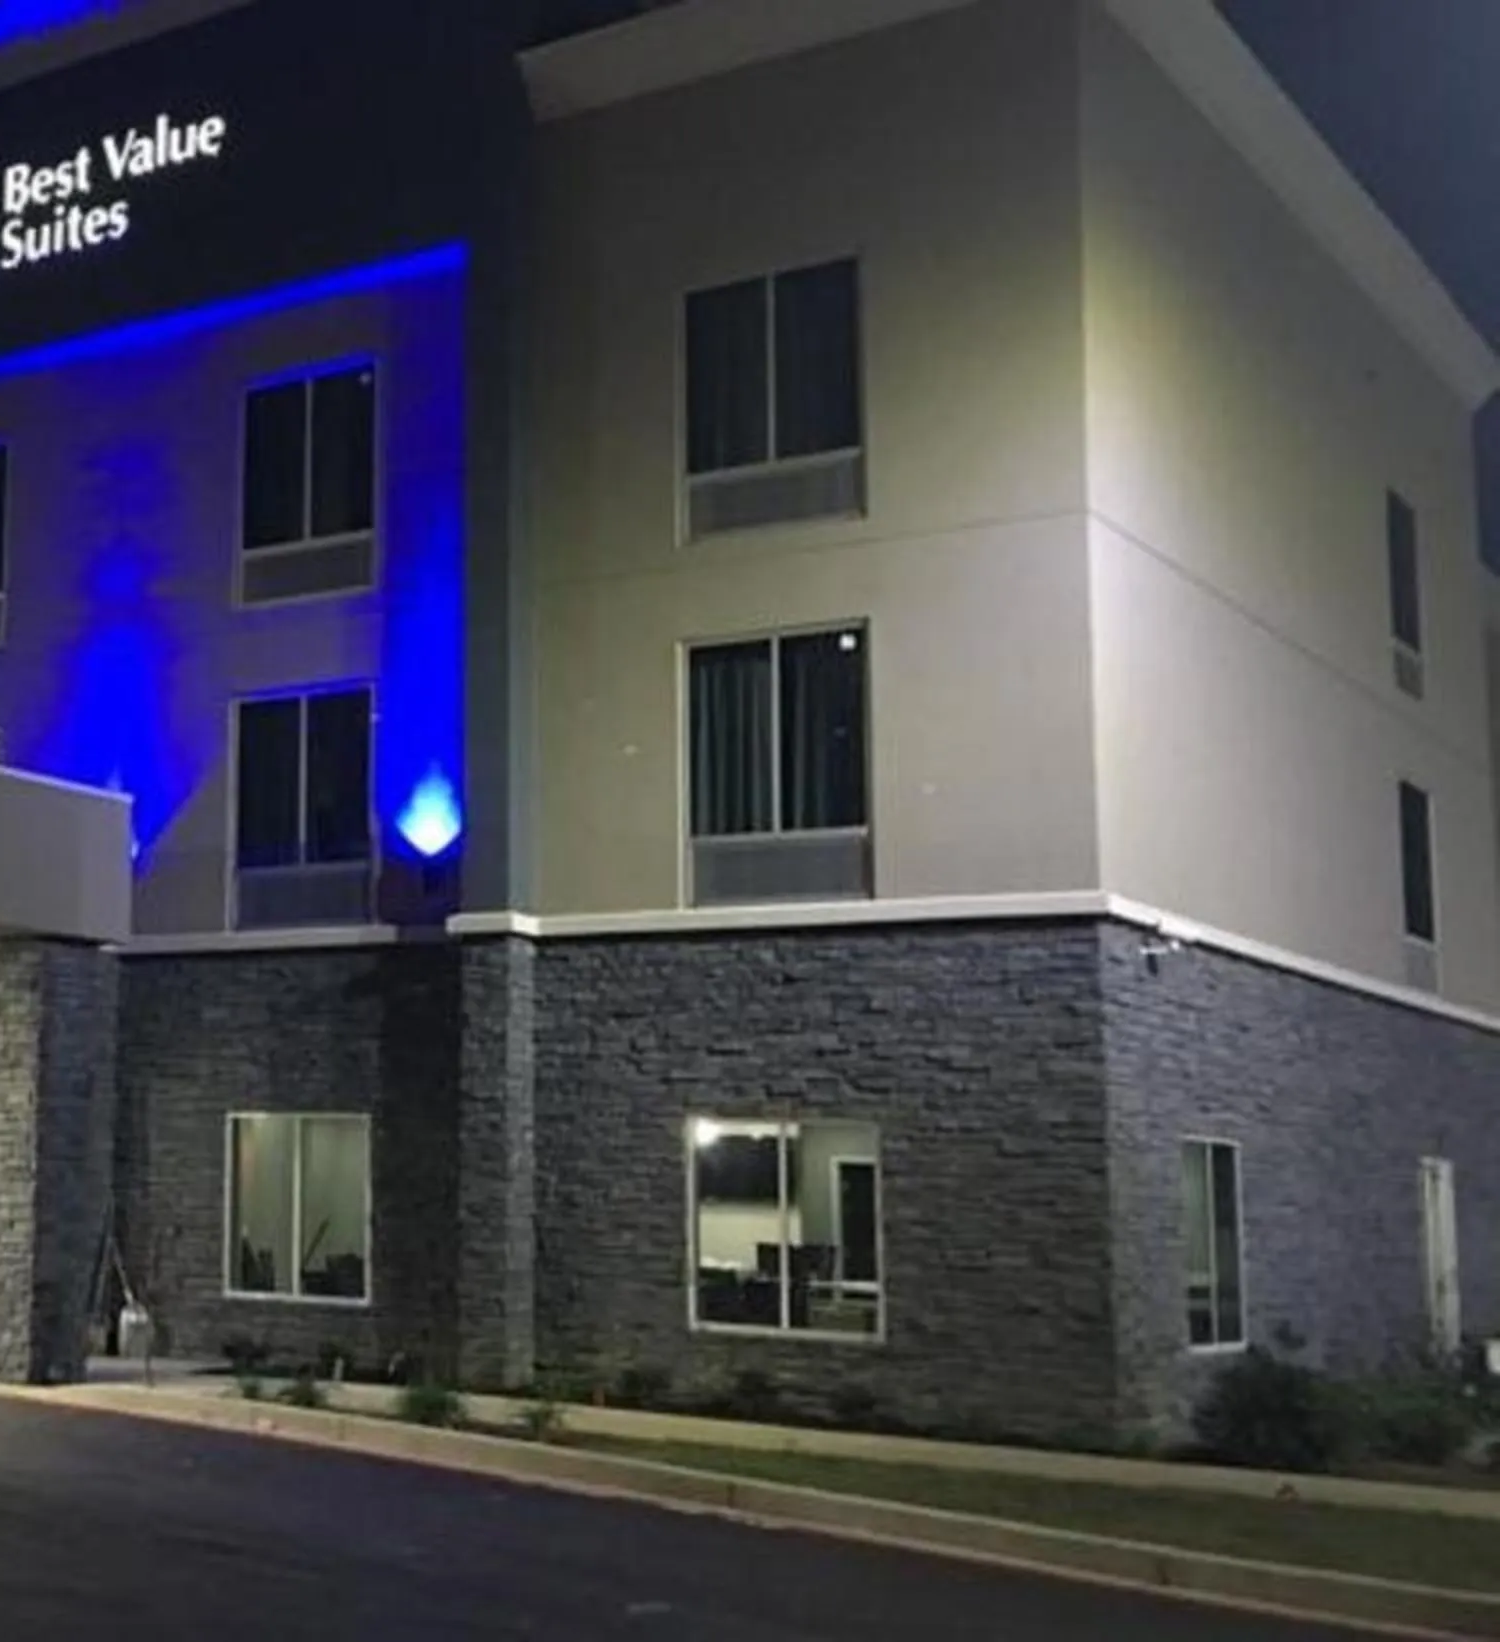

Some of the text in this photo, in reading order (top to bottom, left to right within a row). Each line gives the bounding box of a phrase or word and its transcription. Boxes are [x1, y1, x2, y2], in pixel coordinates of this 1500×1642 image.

[3, 148, 92, 214] Best
[102, 113, 227, 181] Value
[0, 200, 131, 270] Suites
